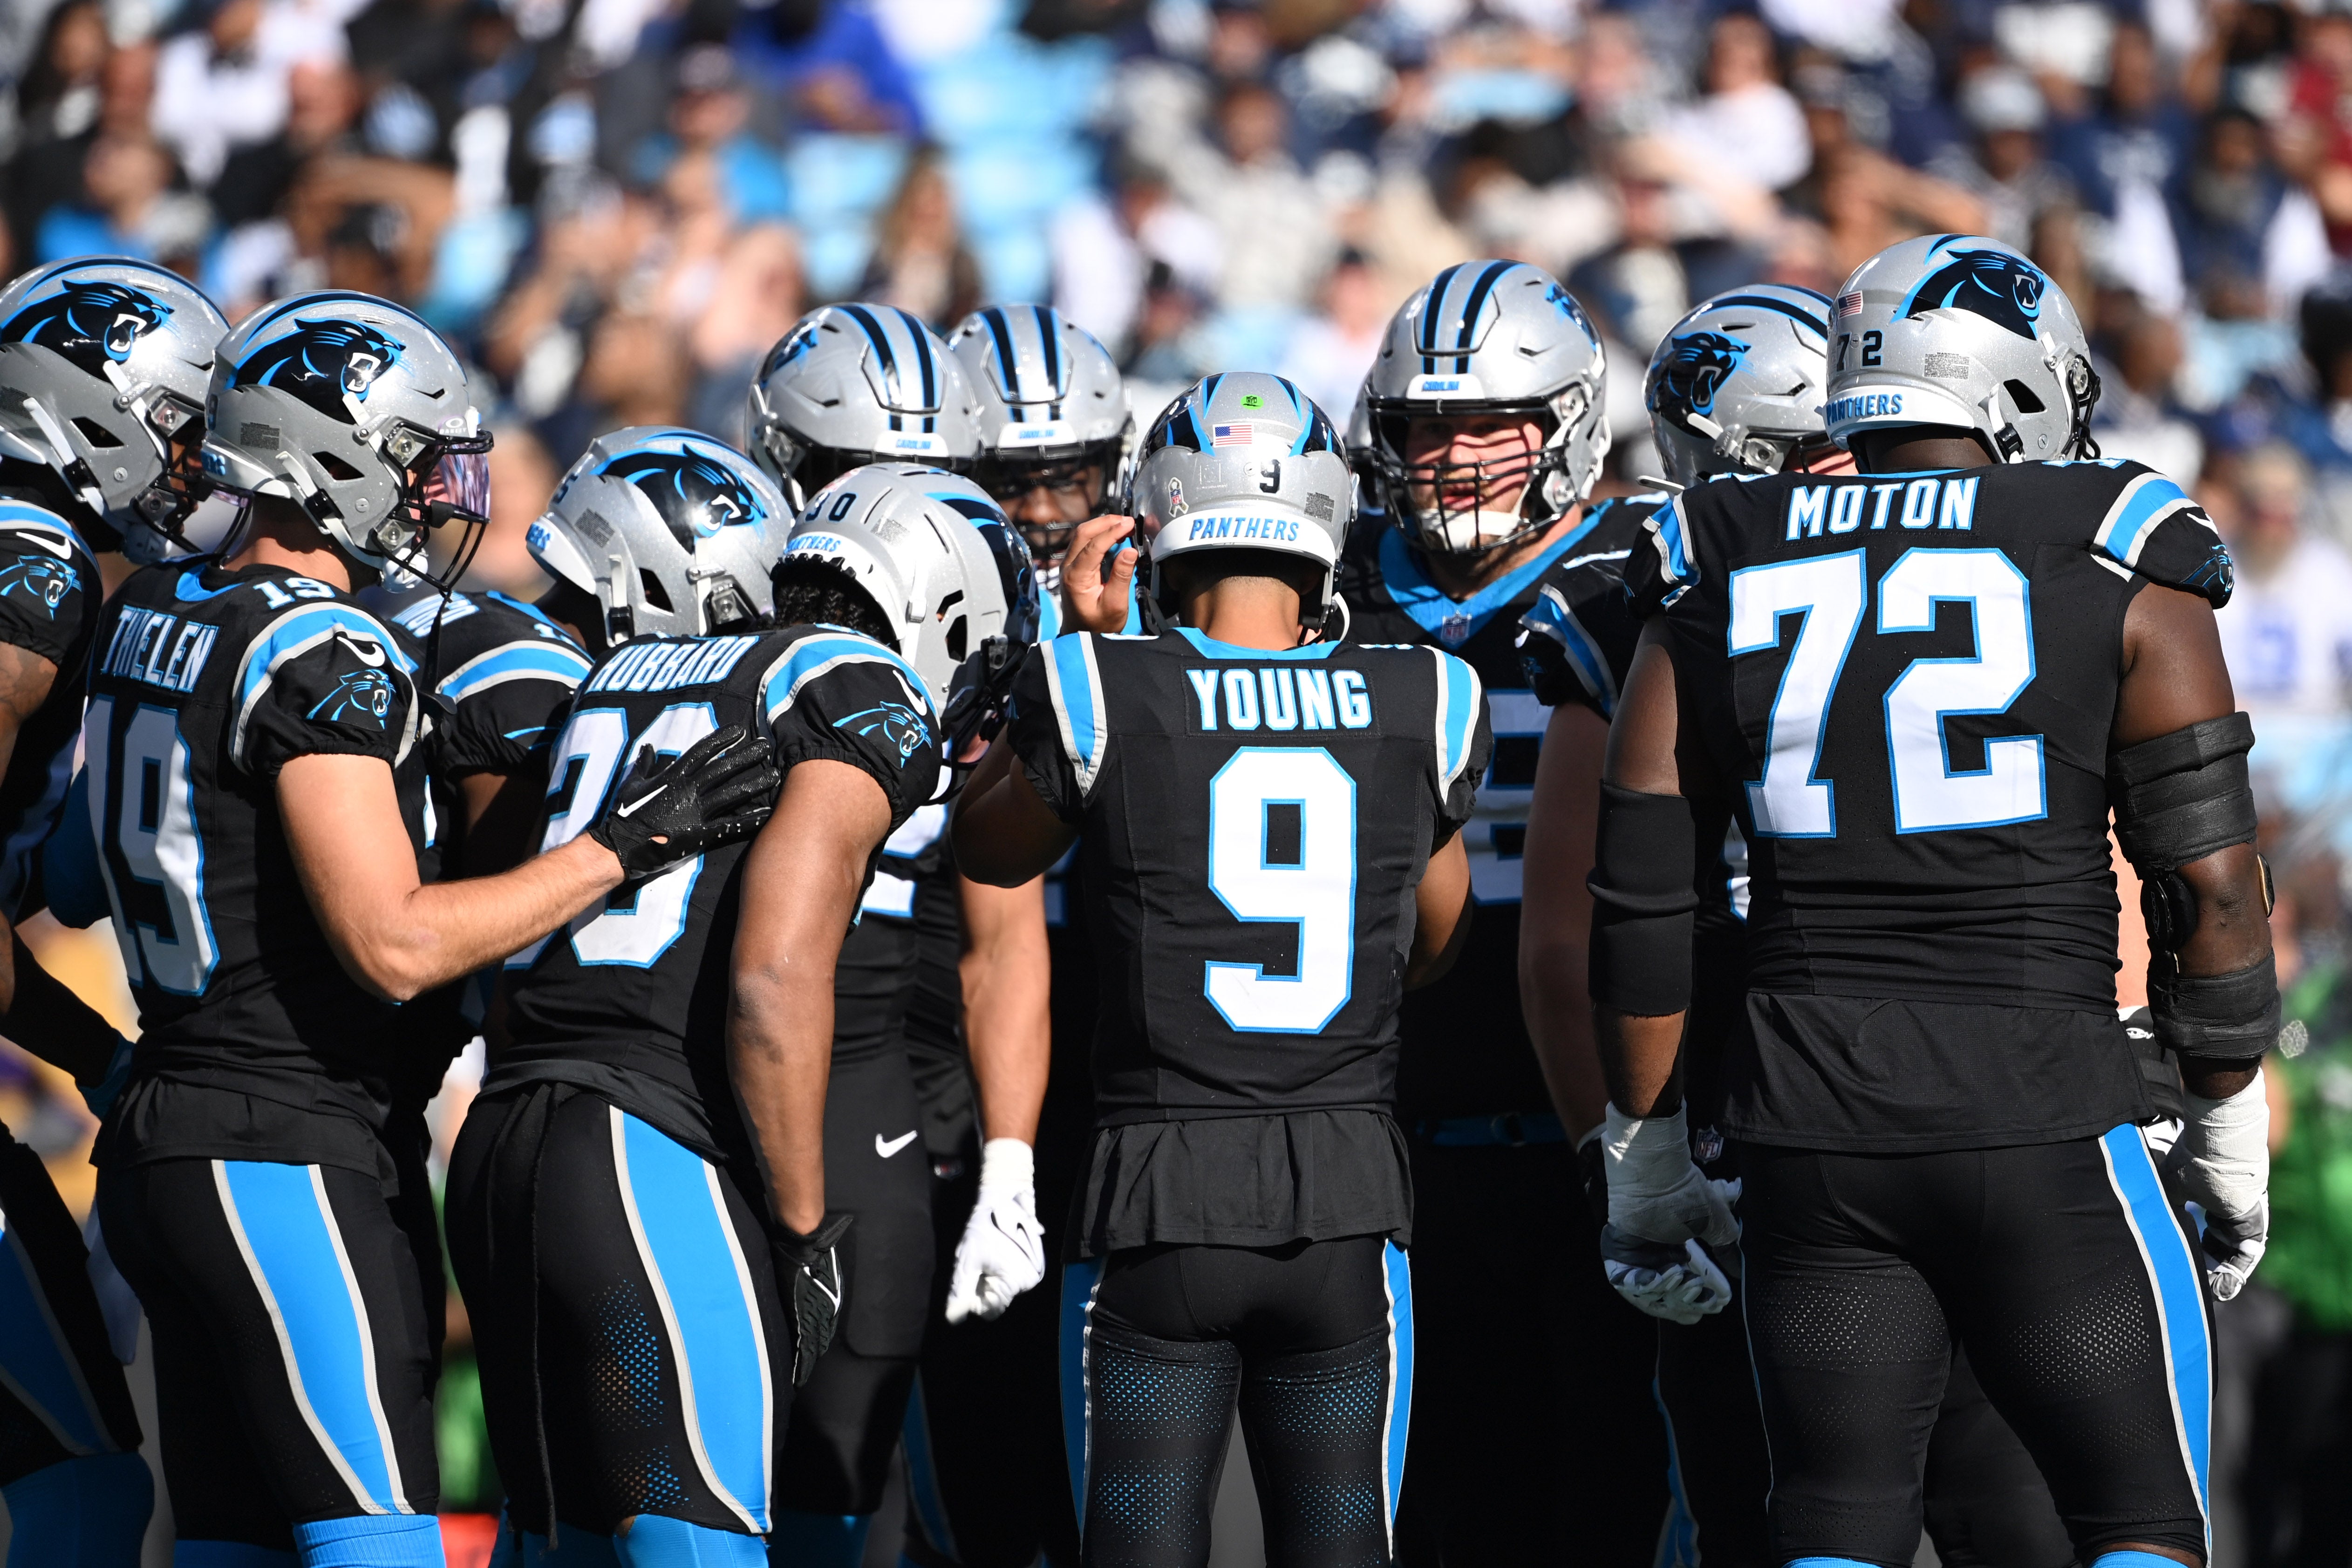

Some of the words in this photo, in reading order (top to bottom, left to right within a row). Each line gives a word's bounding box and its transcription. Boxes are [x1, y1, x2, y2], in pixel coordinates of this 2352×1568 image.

[1836, 329, 1884, 372] 72
[1826, 394, 1903, 426] PANTHERS
[1259, 459, 1281, 494] 9
[1189, 517, 1299, 542] PANTHERS
[1786, 476, 1980, 541] MOTON
[253, 578, 335, 610] 19
[100, 605, 219, 693] THIELEN
[584, 635, 759, 695] HUBBARD
[1186, 668, 1372, 731] YOUNG
[1728, 547, 2048, 838] 72
[85, 693, 219, 996] 19
[1204, 746, 1357, 1034] 9
